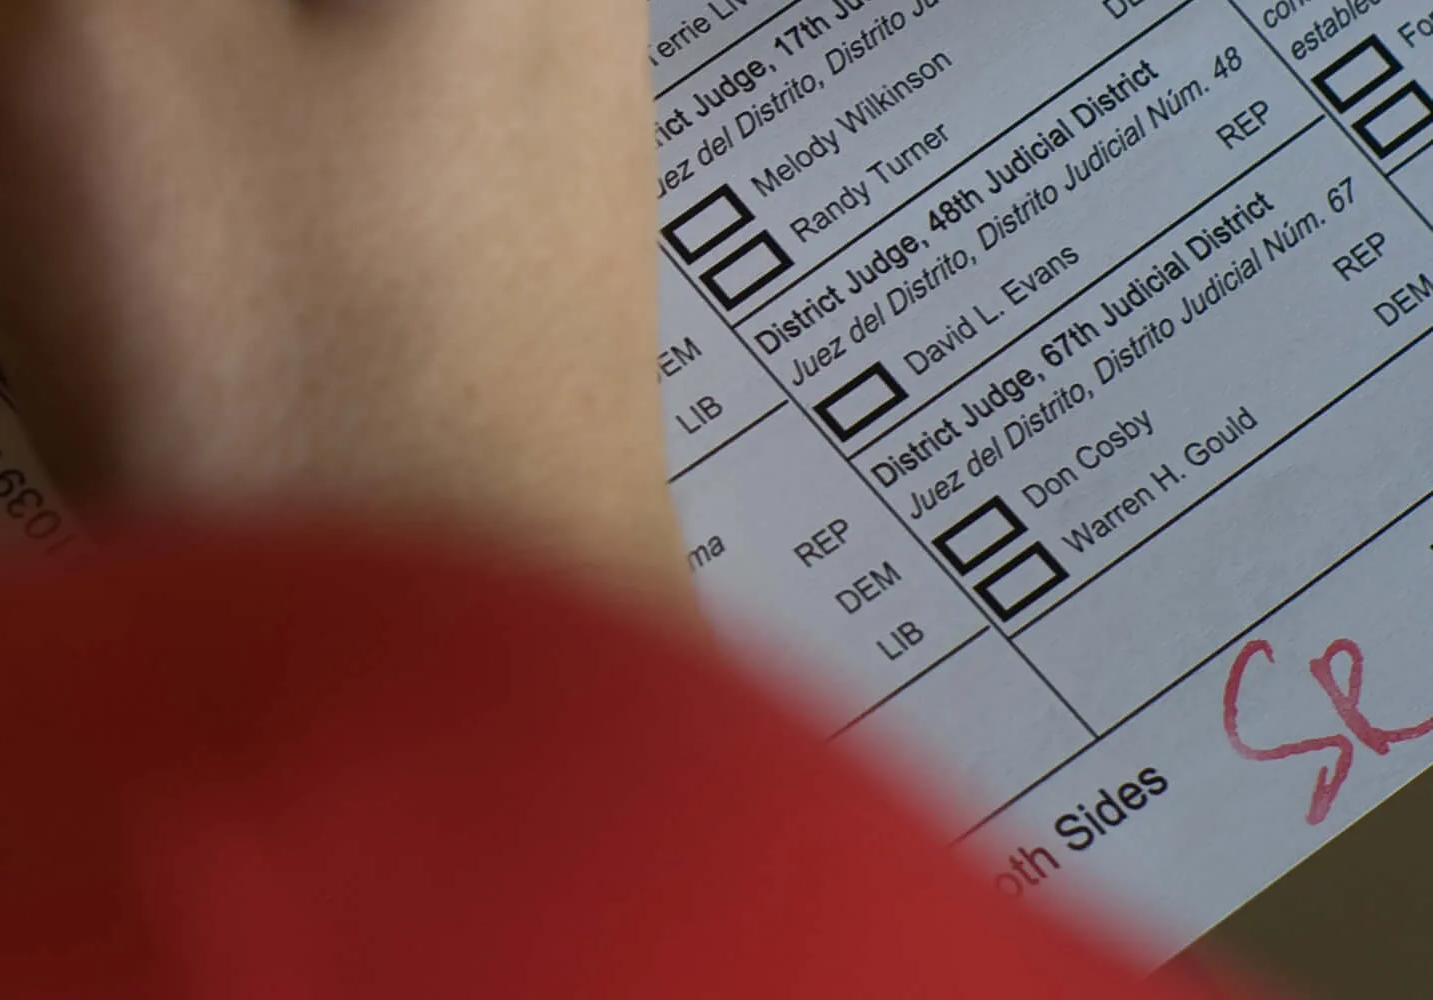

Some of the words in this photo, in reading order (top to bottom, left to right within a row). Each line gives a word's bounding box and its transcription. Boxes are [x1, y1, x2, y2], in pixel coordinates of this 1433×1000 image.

[692, 60, 777, 117] Judge,
[774, 16, 832, 56] 17th
[750, 129, 841, 197] Melody
[834, 52, 953, 134] Wilkinson
[789, 180, 871, 243] Randy
[865, 123, 949, 184] Turner
[753, 285, 846, 356] District
[845, 235, 930, 294] Judge,
[929, 189, 985, 232] 48th
[984, 118, 1075, 194] Judicial
[1069, 59, 1160, 129] District
[870, 418, 963, 489] District
[960, 368, 1046, 428] Judge,
[1040, 322, 1101, 367] 67th
[1100, 250, 1191, 328] Judicial
[1184, 191, 1275, 262] District
[902, 315, 978, 376] David
[972, 305, 1005, 326] L.
[999, 247, 1080, 306] Evans
[1215, 100, 1269, 150] REP
[1021, 467, 1079, 509] Don
[1075, 409, 1154, 470] Cosby
[1331, 231, 1385, 282] REP
[1061, 487, 1156, 553] Warren
[1149, 463, 1186, 493] H.
[1183, 406, 1259, 466] Gould
[1372, 273, 1433, 328] DEM
[1054, 767, 1168, 852] Sides
